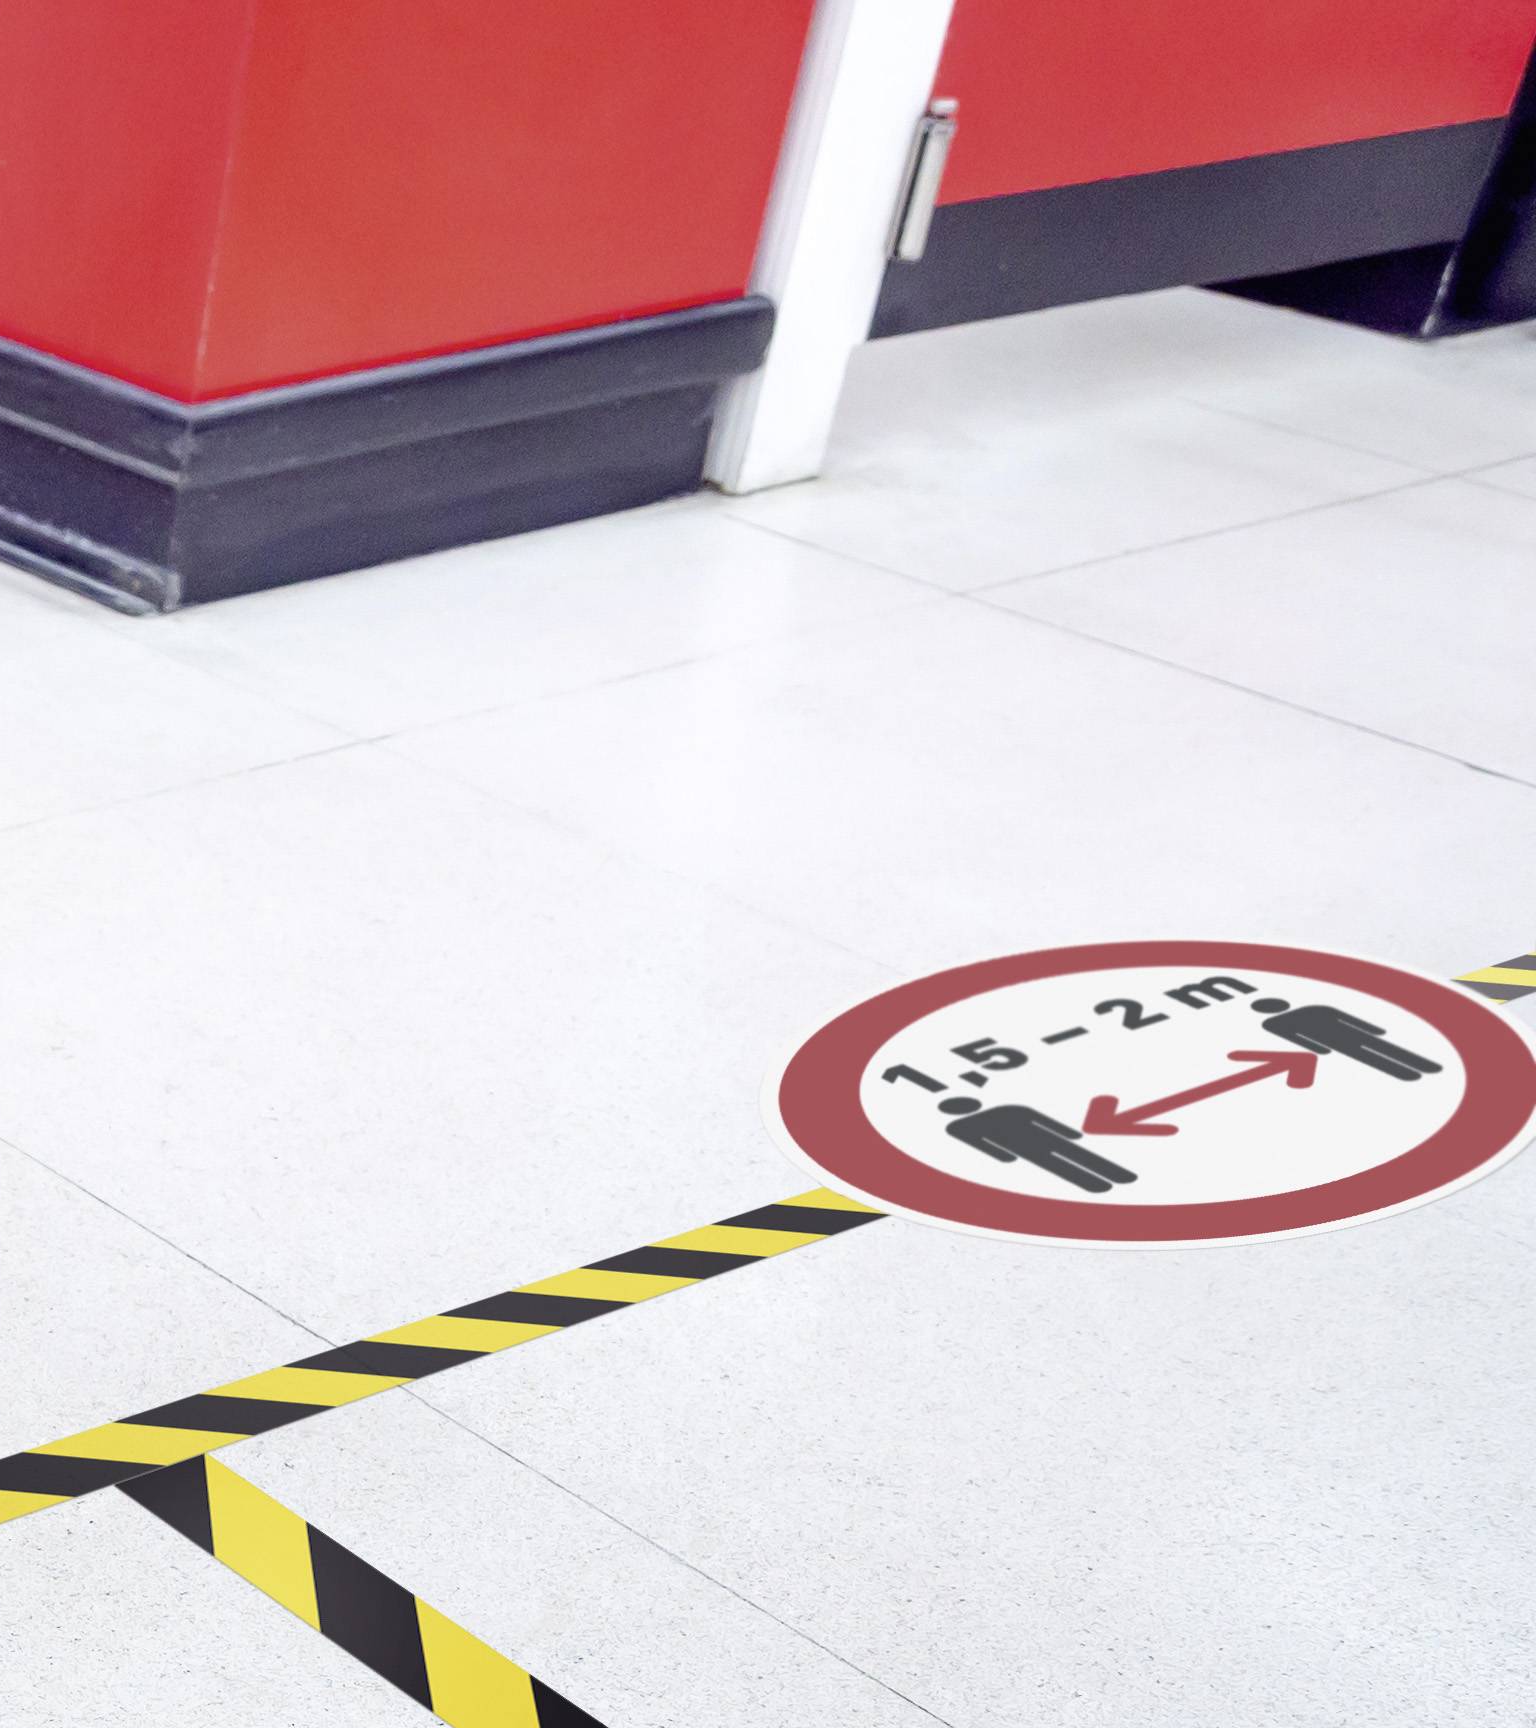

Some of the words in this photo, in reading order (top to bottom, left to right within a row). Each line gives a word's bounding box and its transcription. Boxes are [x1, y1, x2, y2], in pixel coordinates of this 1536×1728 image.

[881, 1037, 1029, 1092] 1,5
[1093, 998, 1169, 1031] 2
[1165, 976, 1258, 1010] m
